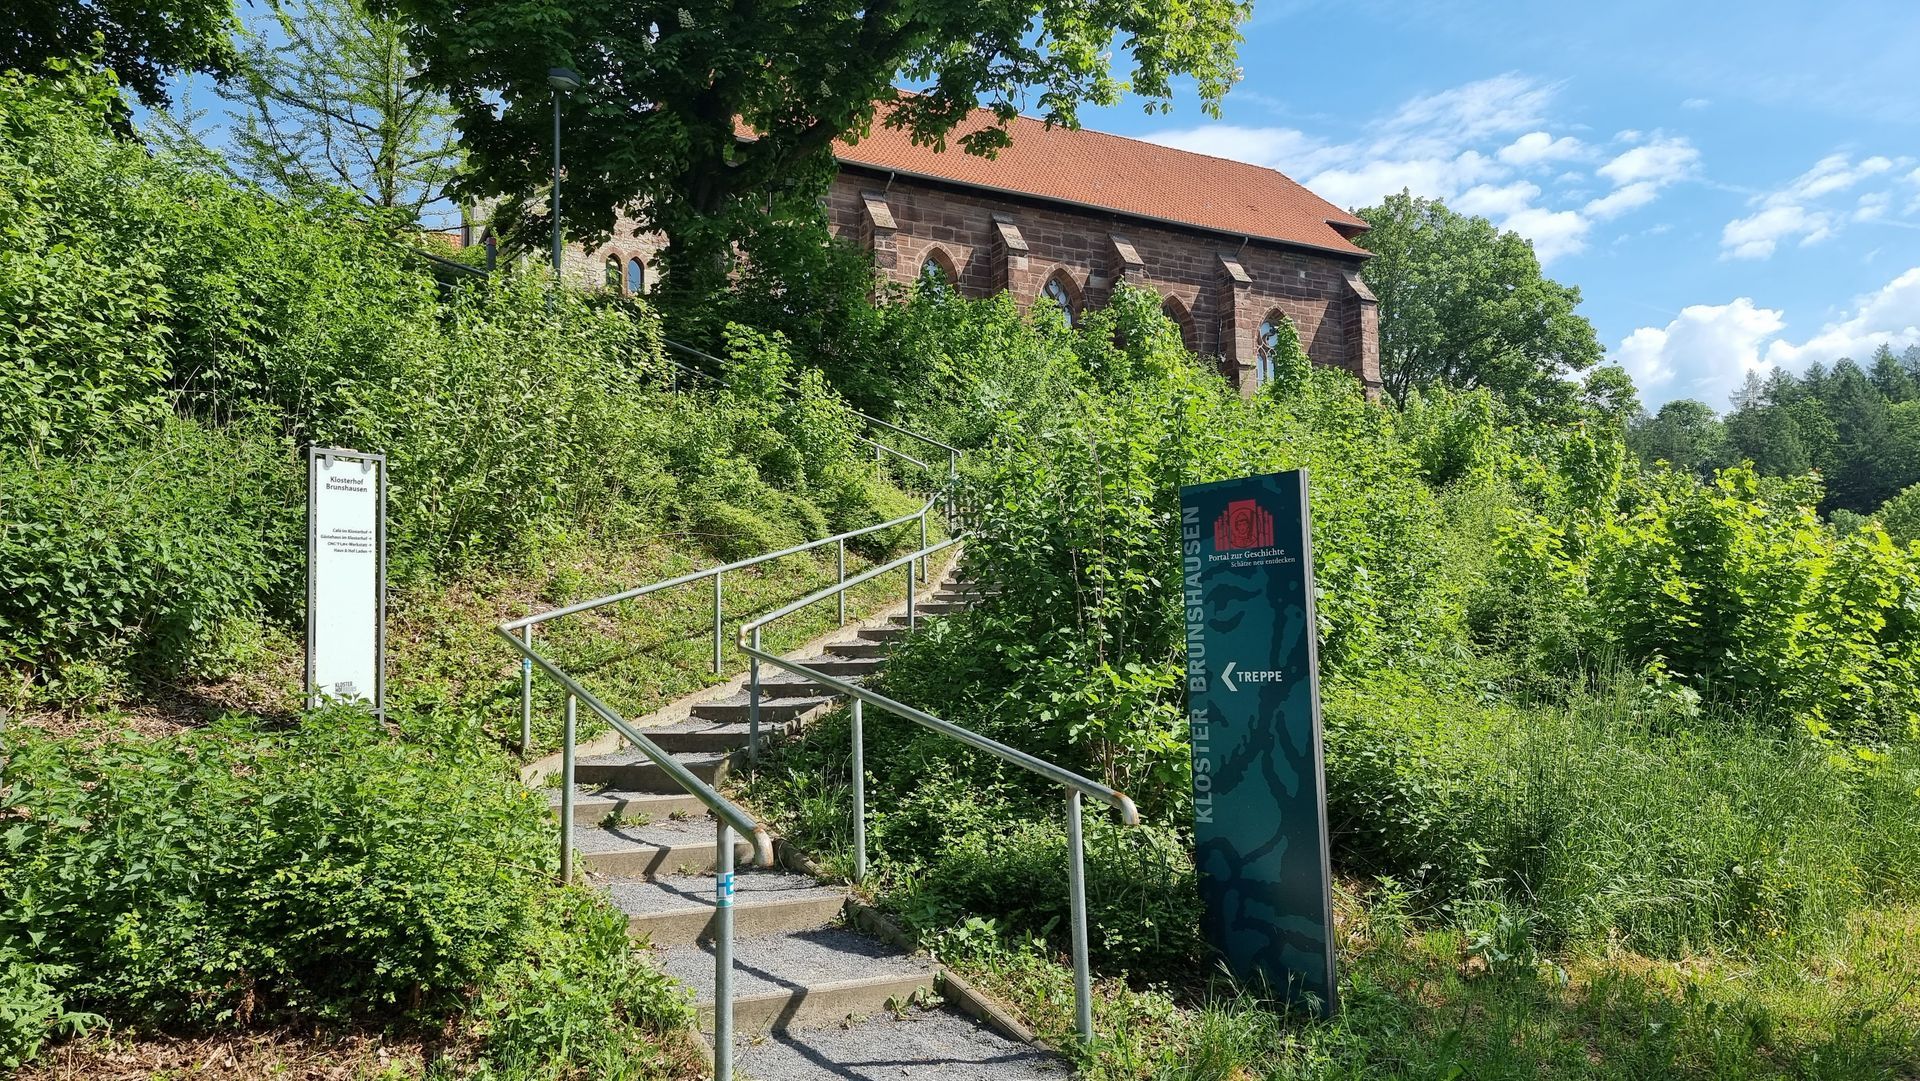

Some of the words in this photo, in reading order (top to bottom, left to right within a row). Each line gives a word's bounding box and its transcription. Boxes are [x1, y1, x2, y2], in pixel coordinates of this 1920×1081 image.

[330, 476, 363, 485] Klosterhof
[326, 483, 367, 492] Brunshausen
[1208, 553, 1229, 562] Portal
[1244, 549, 1285, 559] Geschichte
[1230, 560, 1252, 568] Schätze
[1265, 557, 1296, 565] entdecken
[1182, 506, 1207, 692] BRUNSHAUSEN
[1236, 671, 1283, 682] TREPPE
[1191, 708, 1213, 824] KLOSTER
